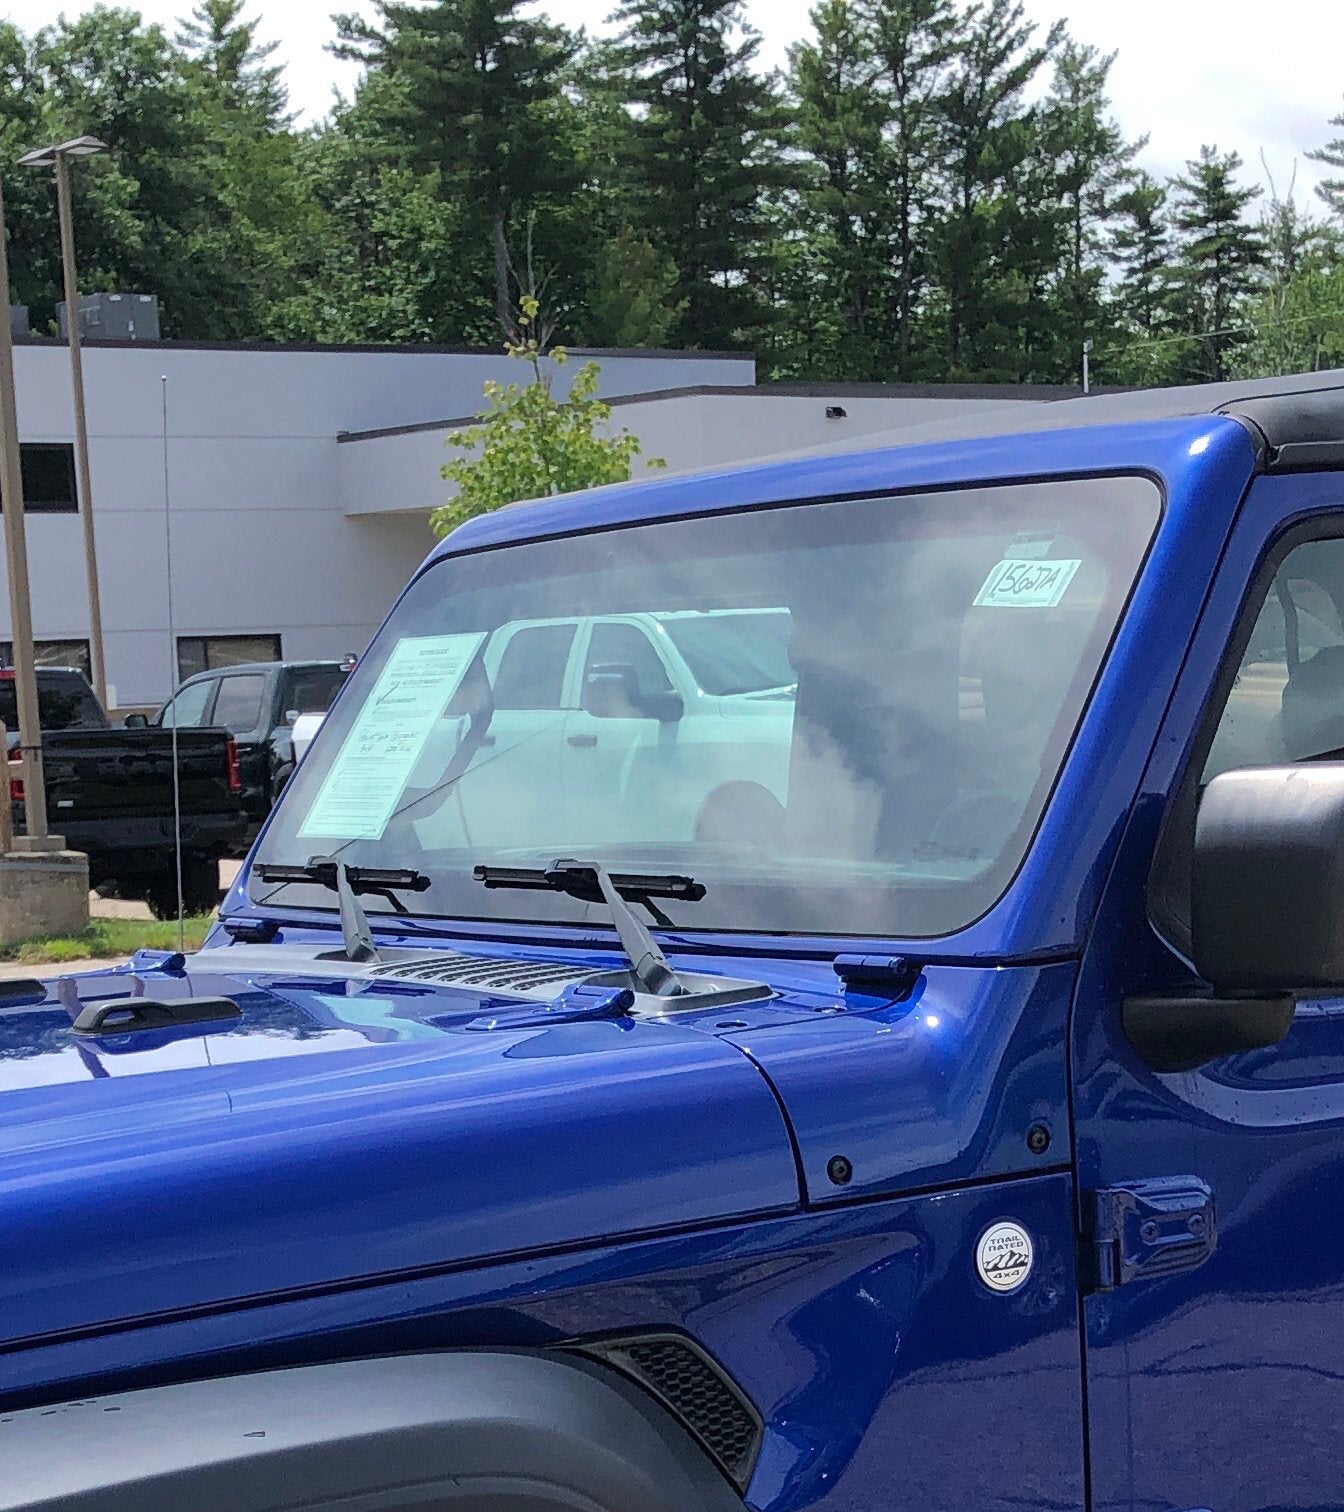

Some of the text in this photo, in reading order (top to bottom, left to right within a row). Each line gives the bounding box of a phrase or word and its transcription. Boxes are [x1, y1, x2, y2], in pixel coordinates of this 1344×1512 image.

[990, 1236, 1021, 1244] TRAIL
[988, 1241, 1023, 1251] RATED
[993, 1270, 1019, 1278] 4x4
